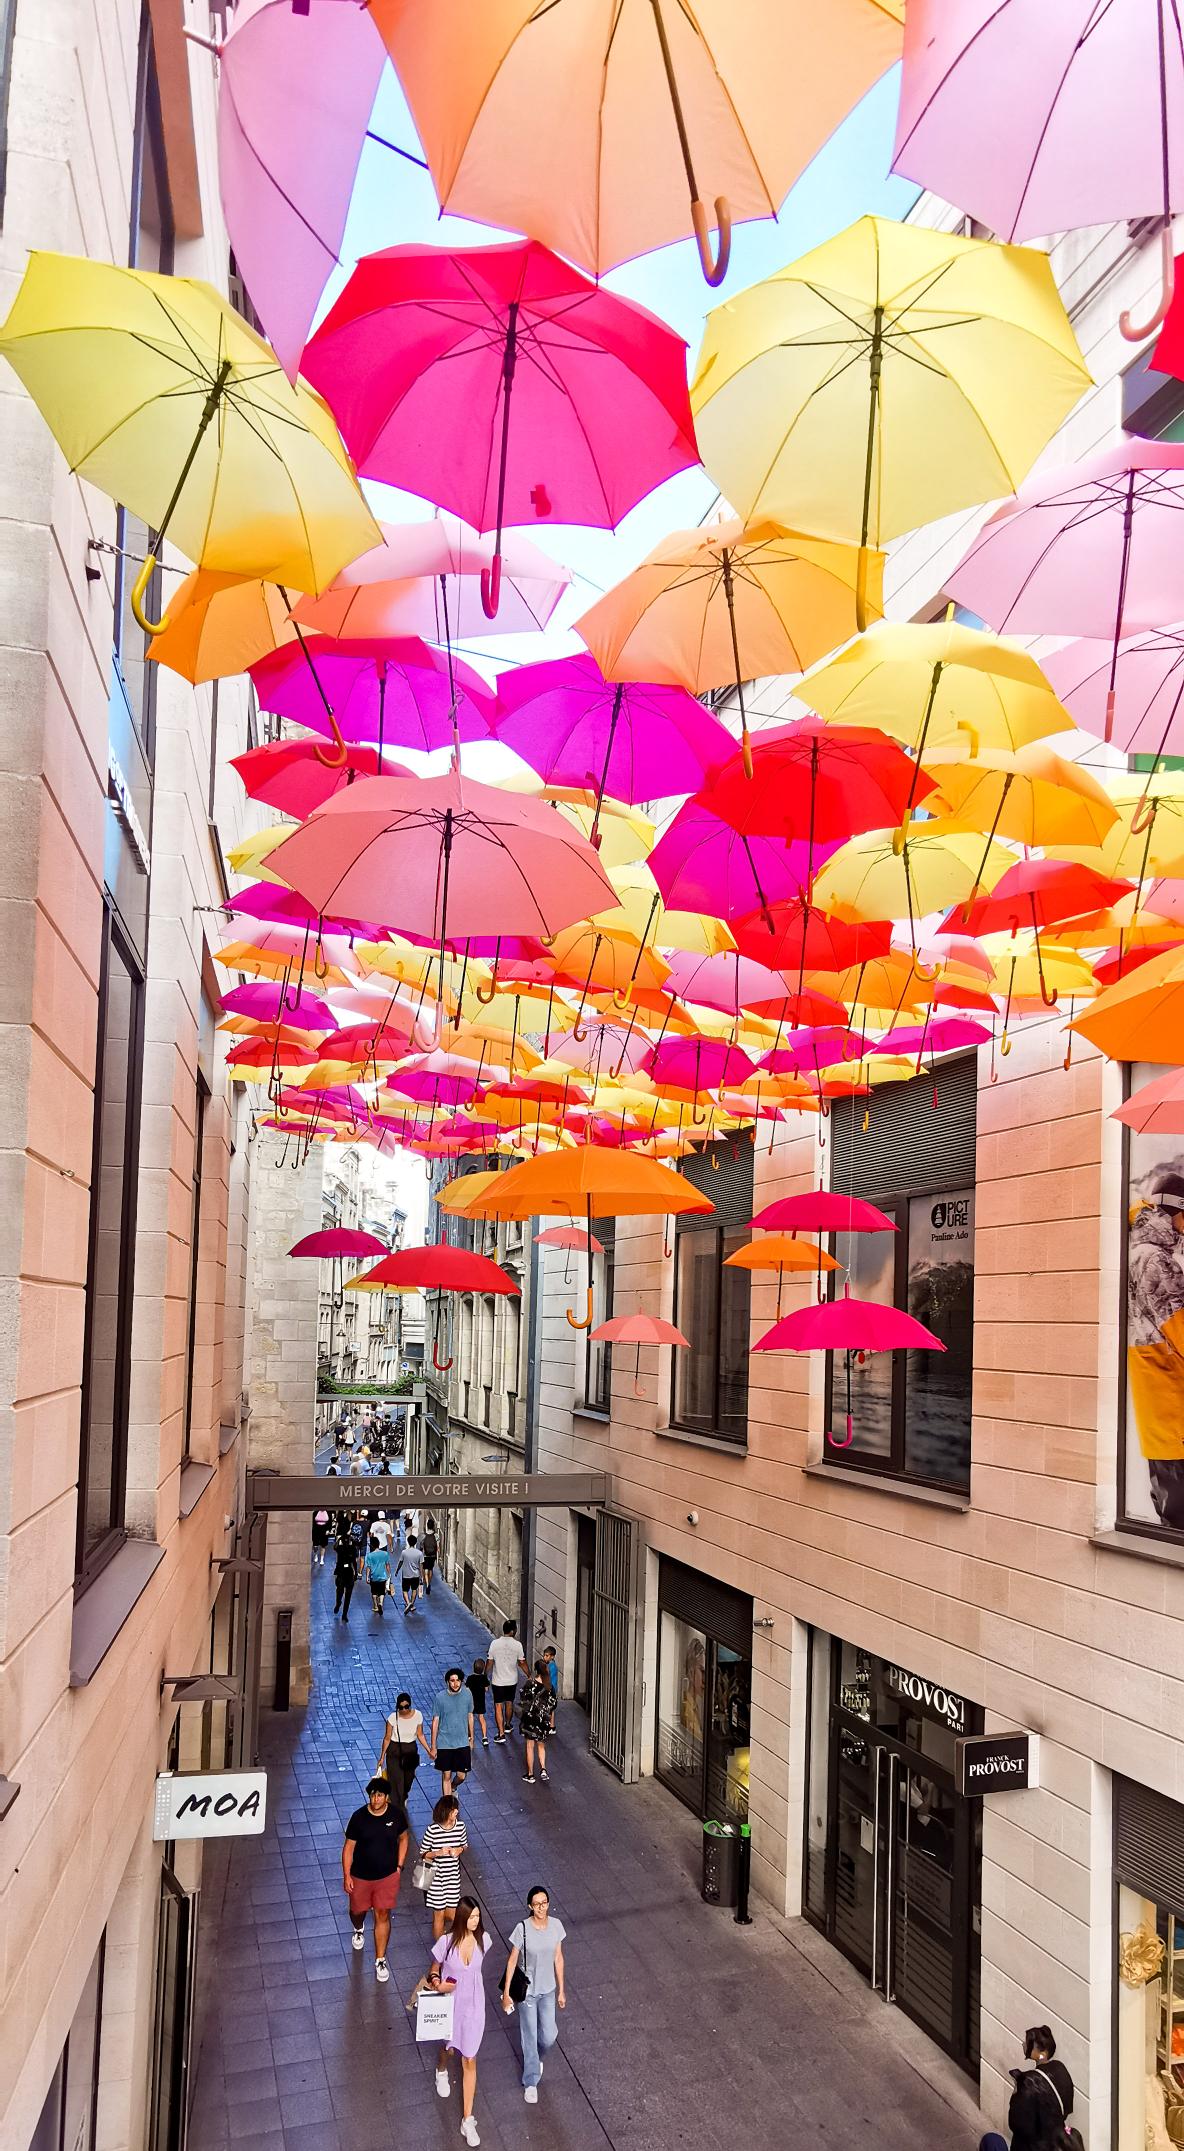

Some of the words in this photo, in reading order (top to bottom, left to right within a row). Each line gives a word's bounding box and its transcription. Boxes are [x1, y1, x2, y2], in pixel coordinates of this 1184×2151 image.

[947, 1199, 970, 1214] PICT
[947, 1213, 968, 1227] URE
[339, 1484, 390, 1498] MERCI
[396, 1484, 415, 1496] DE
[421, 1483, 469, 1496] VOTRE
[475, 1482, 519, 1495] VISITE
[889, 1665, 965, 1724] PROVOST
[947, 1718, 964, 1733] PARI
[986, 1754, 1010, 1763] FRANCK
[969, 1759, 1024, 1776] PROVOST
[175, 1790, 260, 1820] MOA
